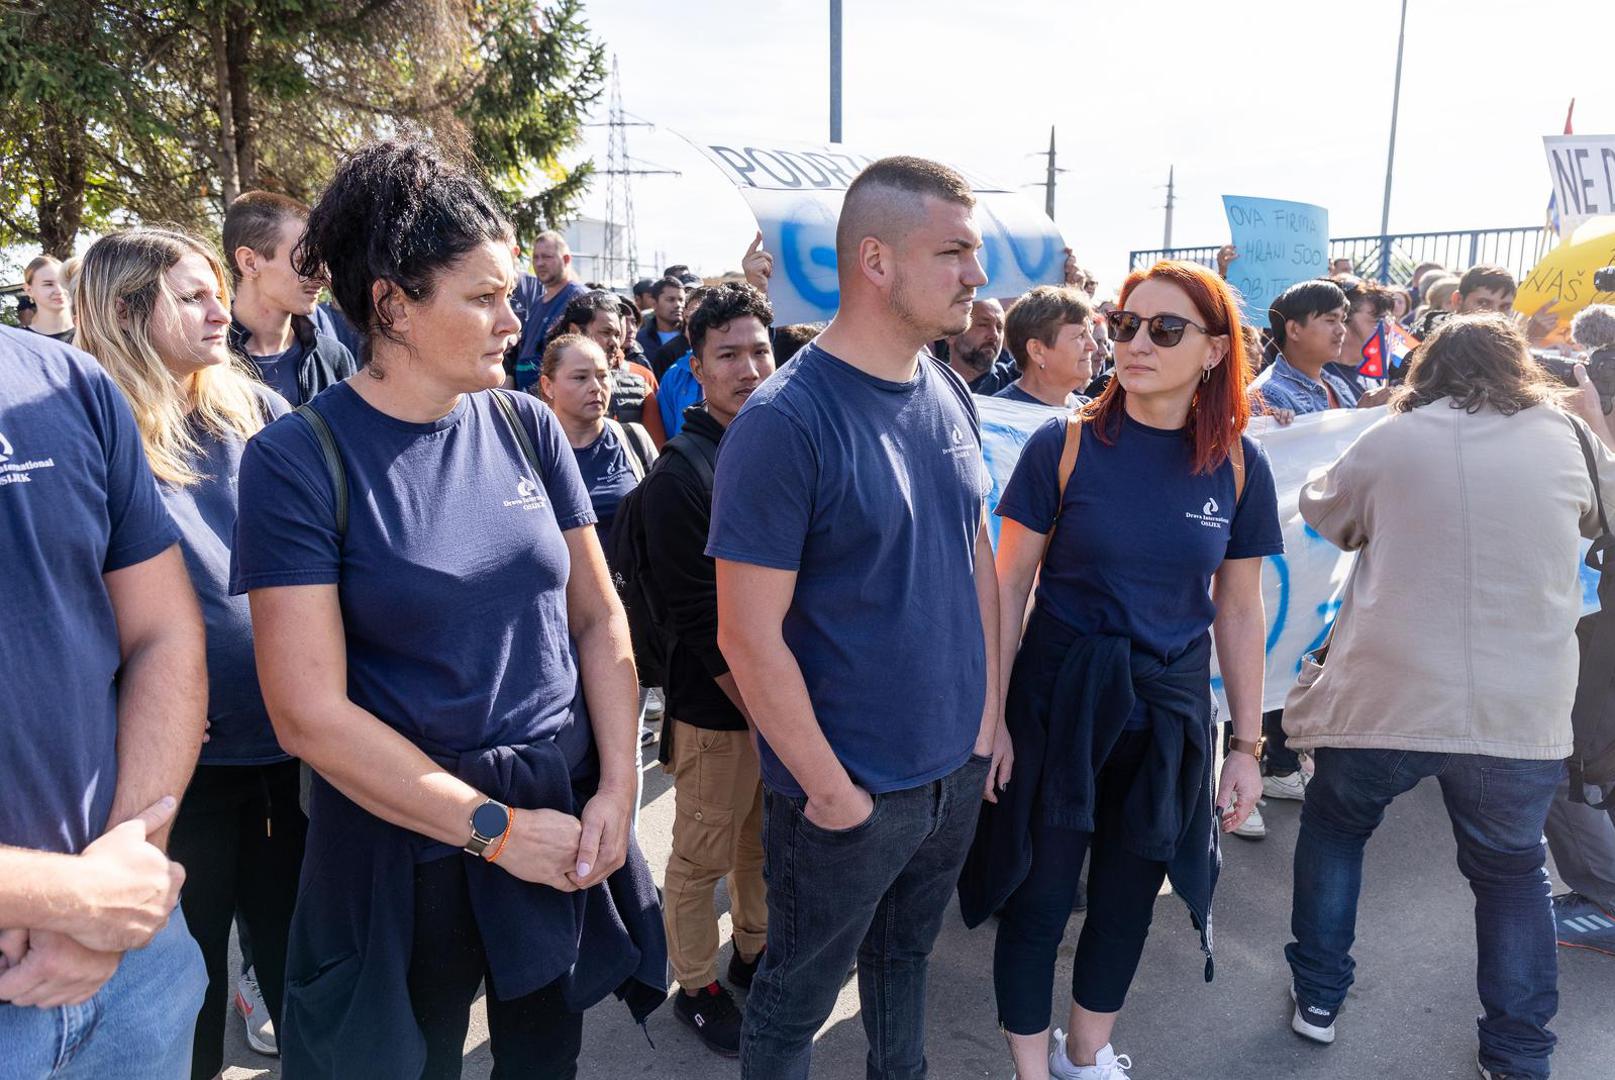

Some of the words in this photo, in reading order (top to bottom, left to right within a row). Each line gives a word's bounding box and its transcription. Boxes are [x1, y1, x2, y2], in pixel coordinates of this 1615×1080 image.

[1552, 148, 1598, 215] NE
[1230, 205, 1265, 228] OVA
[1274, 209, 1316, 232] FIRMA
[1291, 243, 1321, 266] 500
[1241, 277, 1292, 300] OBITE
[1524, 267, 1585, 302] NAŠ
[0, 457, 54, 473] nternational
[0, 473, 31, 485] SIJEK
